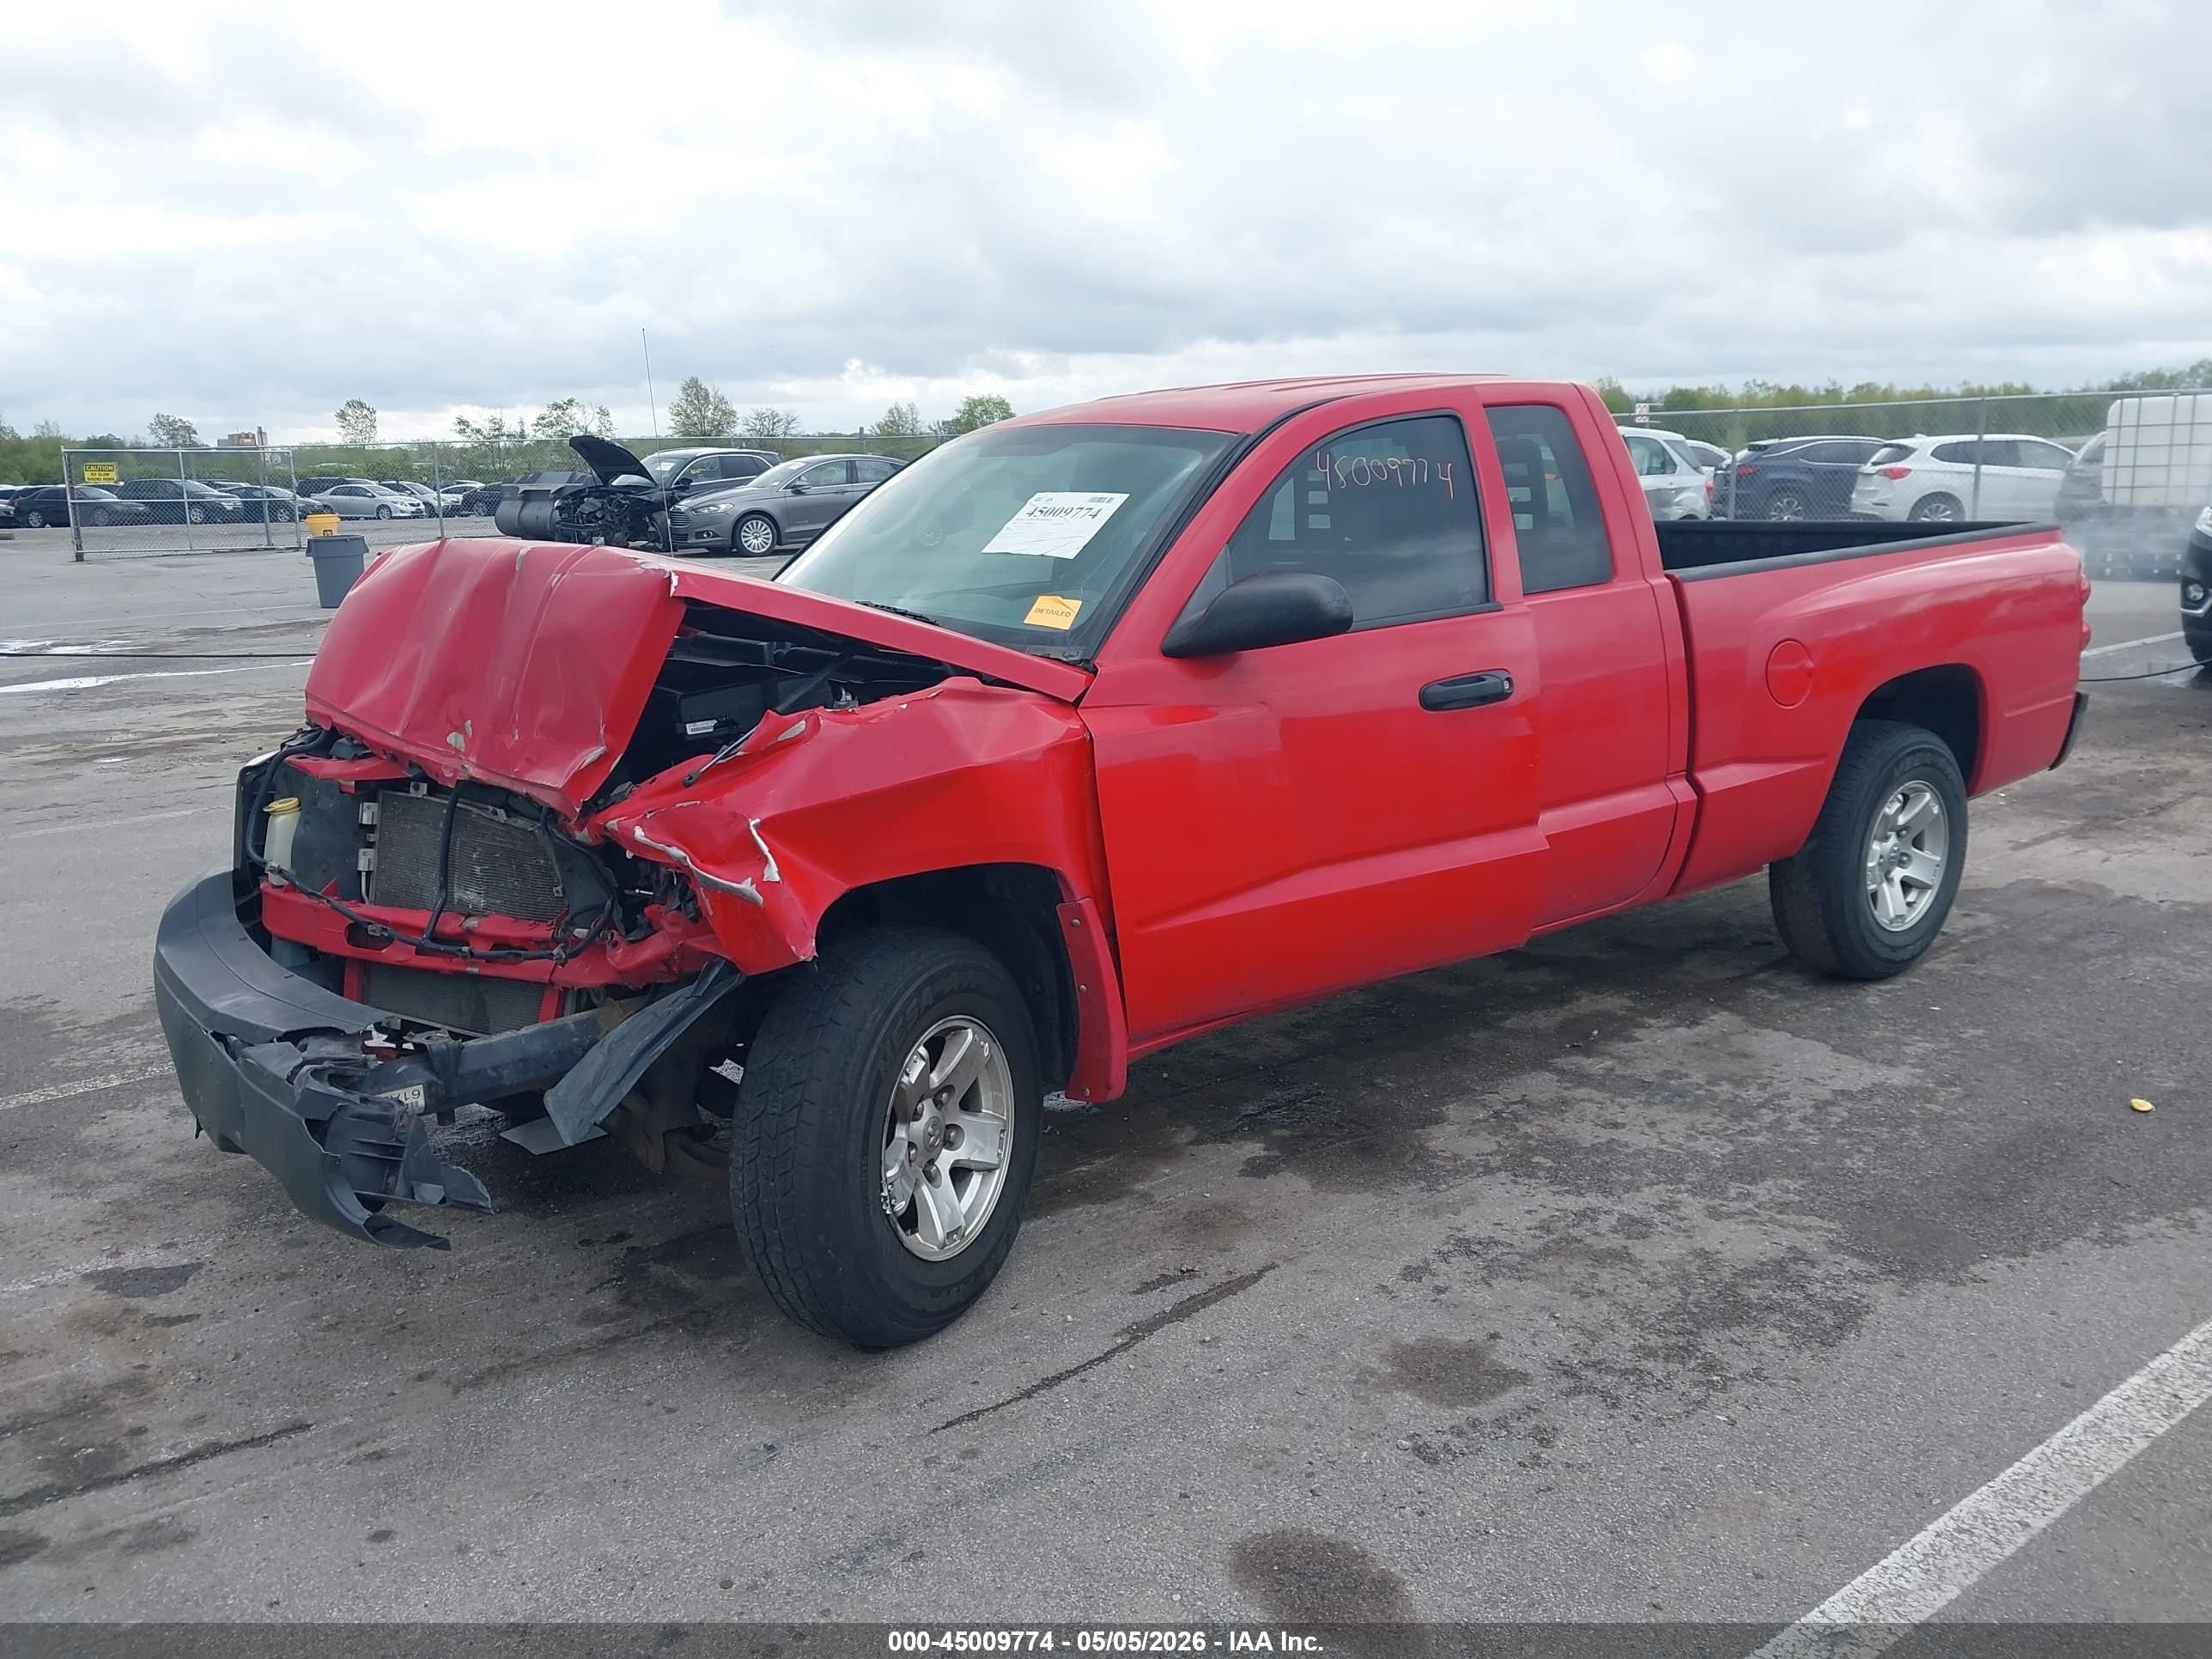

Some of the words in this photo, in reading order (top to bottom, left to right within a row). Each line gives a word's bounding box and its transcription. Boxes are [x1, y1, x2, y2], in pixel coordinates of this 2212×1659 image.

[1316, 451, 1454, 500] 45009774
[1026, 506, 1103, 520] 45009774
[1034, 607, 1072, 617] DETAILED
